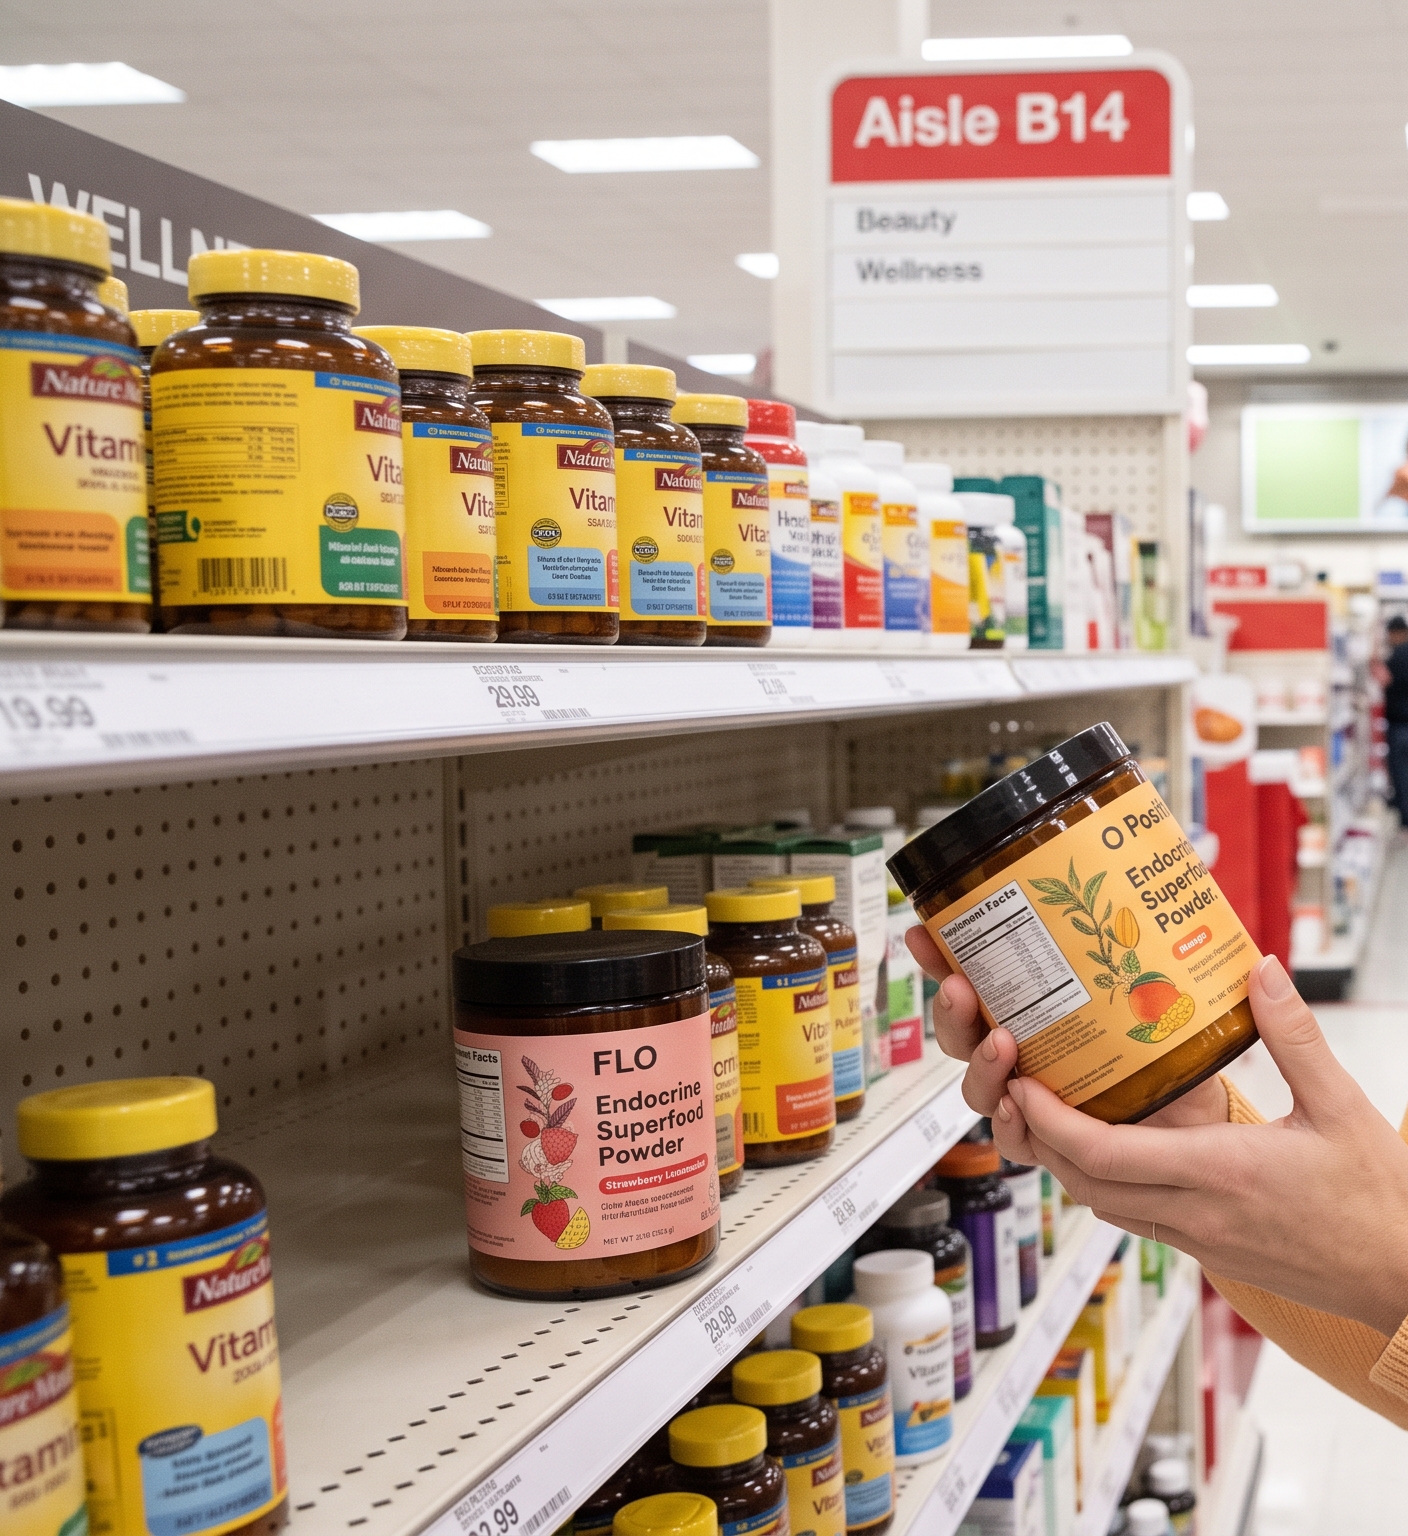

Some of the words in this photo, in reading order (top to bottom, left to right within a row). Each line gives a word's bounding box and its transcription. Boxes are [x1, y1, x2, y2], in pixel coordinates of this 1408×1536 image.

[853, 94, 999, 149] Aisle
[1016, 90, 1130, 145] B14
[856, 207, 957, 237] Beauty
[856, 257, 984, 285] Wellness
[488, 685, 540, 708] 29.99
[1101, 825, 1124, 850] O
[472, 1050, 499, 1064] Facts
[593, 1045, 657, 1076] FLO
[596, 1081, 701, 1115] Endocrine
[597, 1099, 704, 1143] Superfood
[598, 1137, 685, 1167] Powder
